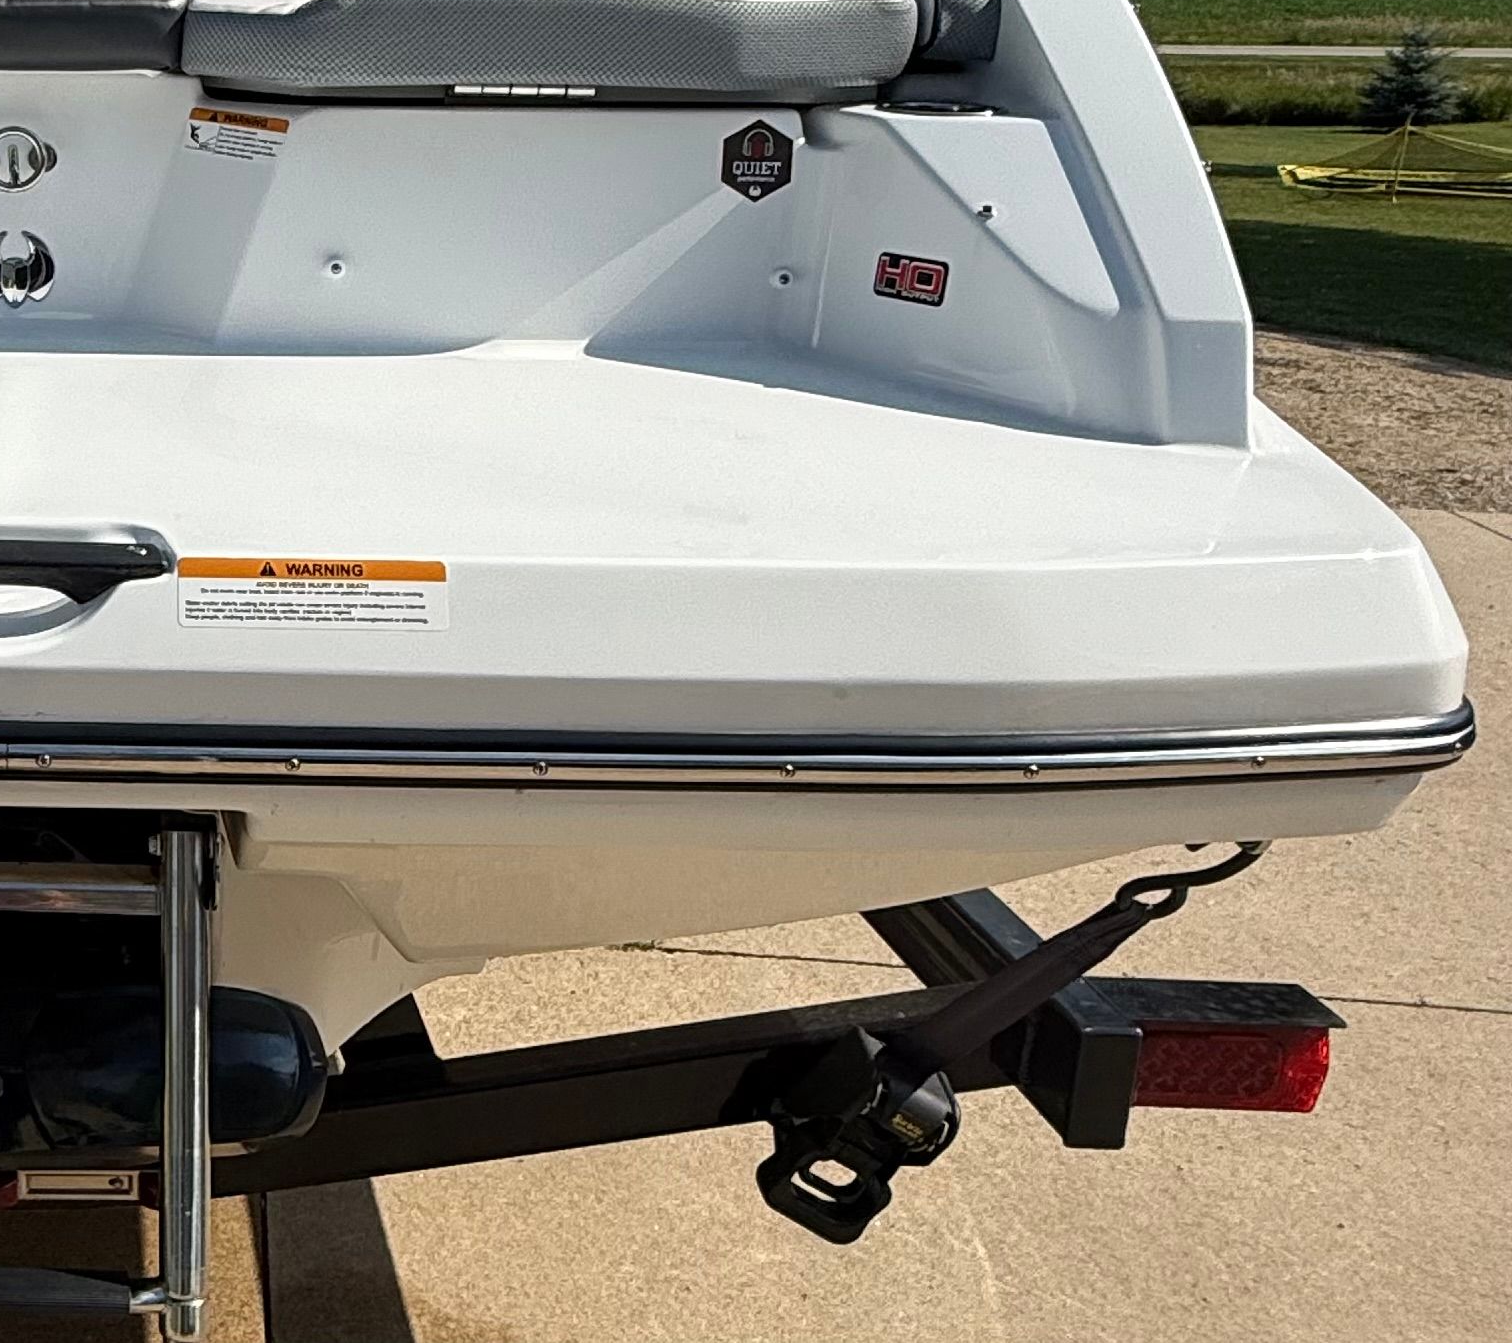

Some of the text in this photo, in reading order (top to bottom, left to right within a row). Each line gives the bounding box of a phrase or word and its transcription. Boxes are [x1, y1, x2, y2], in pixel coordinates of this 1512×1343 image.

[732, 160, 782, 175] QUIET
[876, 256, 945, 296] HO
[285, 563, 364, 577] WARNING
